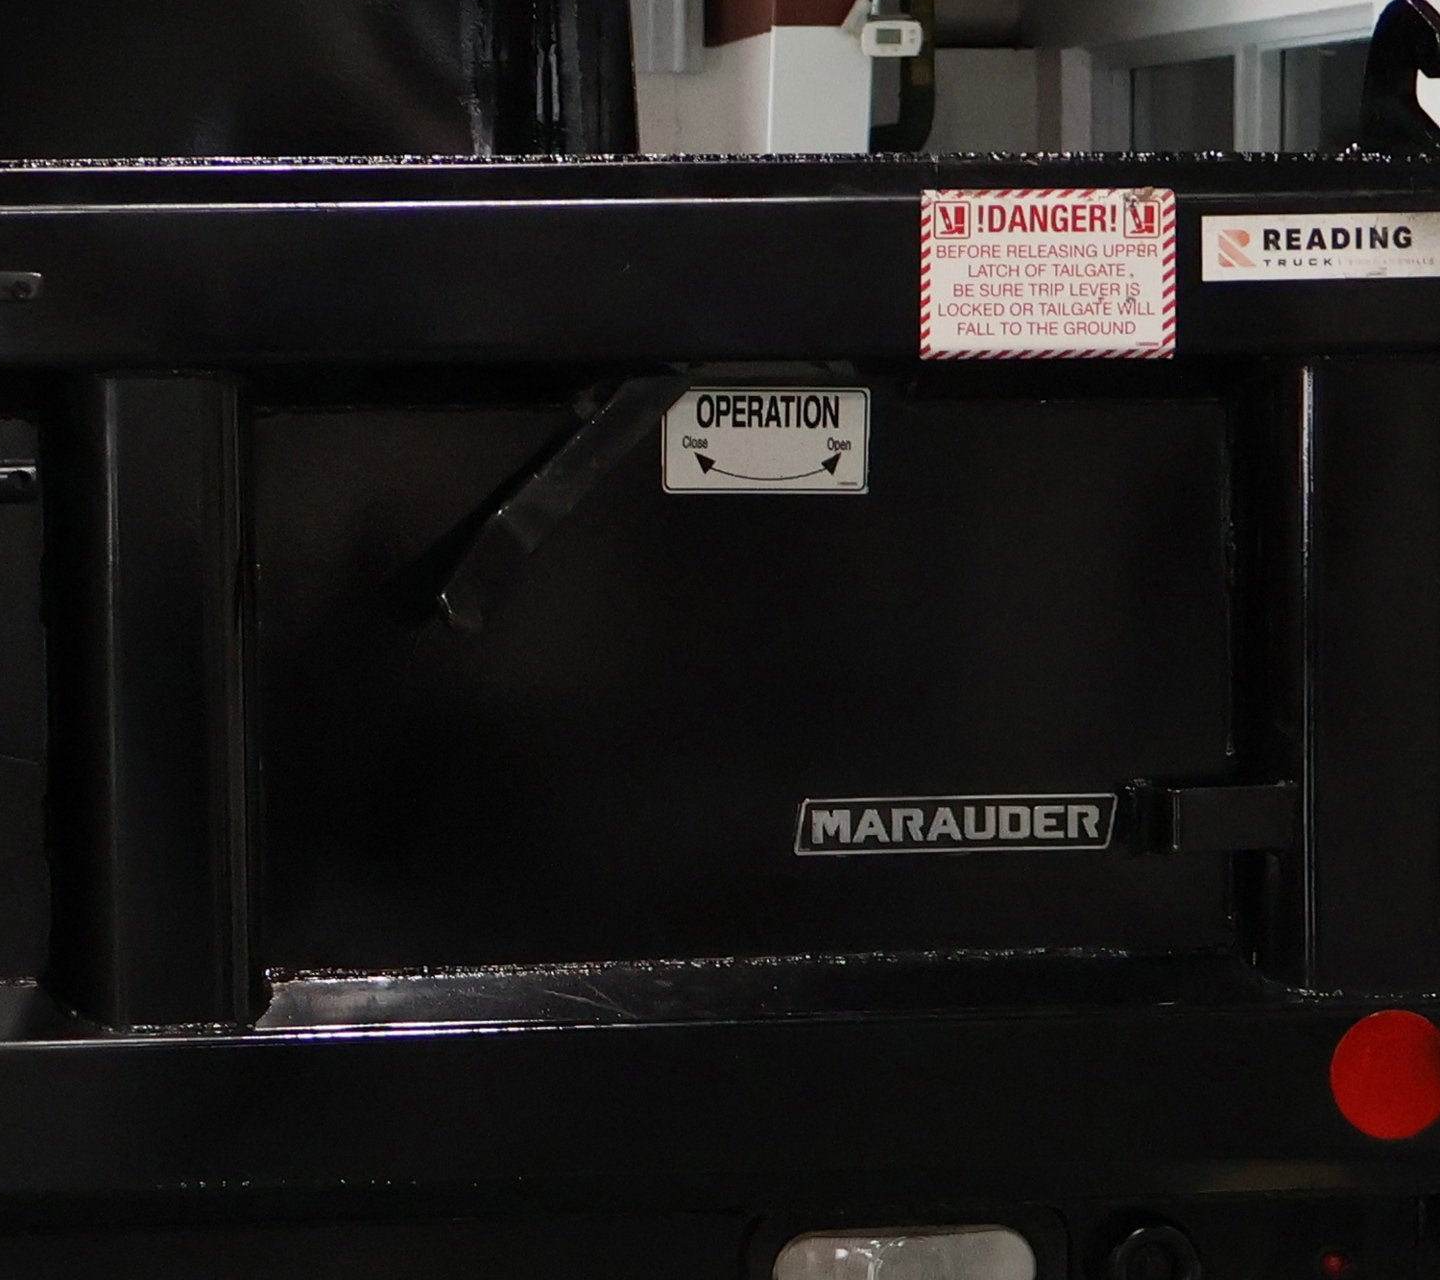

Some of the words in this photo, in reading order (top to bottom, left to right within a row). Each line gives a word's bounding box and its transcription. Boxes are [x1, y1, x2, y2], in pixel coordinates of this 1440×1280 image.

[1264, 227, 1413, 251] READING
[936, 244, 1002, 259] BEFORE
[1006, 244, 1098, 259] RELEASING
[1102, 243, 1158, 258] UPPER
[967, 264, 1021, 278] LATCH
[1024, 263, 1048, 278] OF
[1263, 258, 1333, 268] TRUCK
[953, 284, 975, 297] BE
[979, 283, 1023, 297] SURE
[1028, 283, 1064, 297] TRIP
[1069, 282, 1121, 297] LEVER
[1126, 282, 1141, 296] IS
[937, 303, 1005, 317] LOCKED
[1009, 302, 1034, 317] OR
[1038, 302, 1113, 316] TAILGATE
[1117, 300, 1155, 316] WILL
[957, 321, 995, 336] FALL
[999, 321, 1022, 336] TO
[1027, 321, 1060, 336] THE
[1064, 320, 1137, 336] GROUND
[696, 394, 840, 429] OPERATION
[682, 435, 708, 450] Close
[827, 437, 851, 453] Open
[811, 805, 1100, 845] MARAUDER
